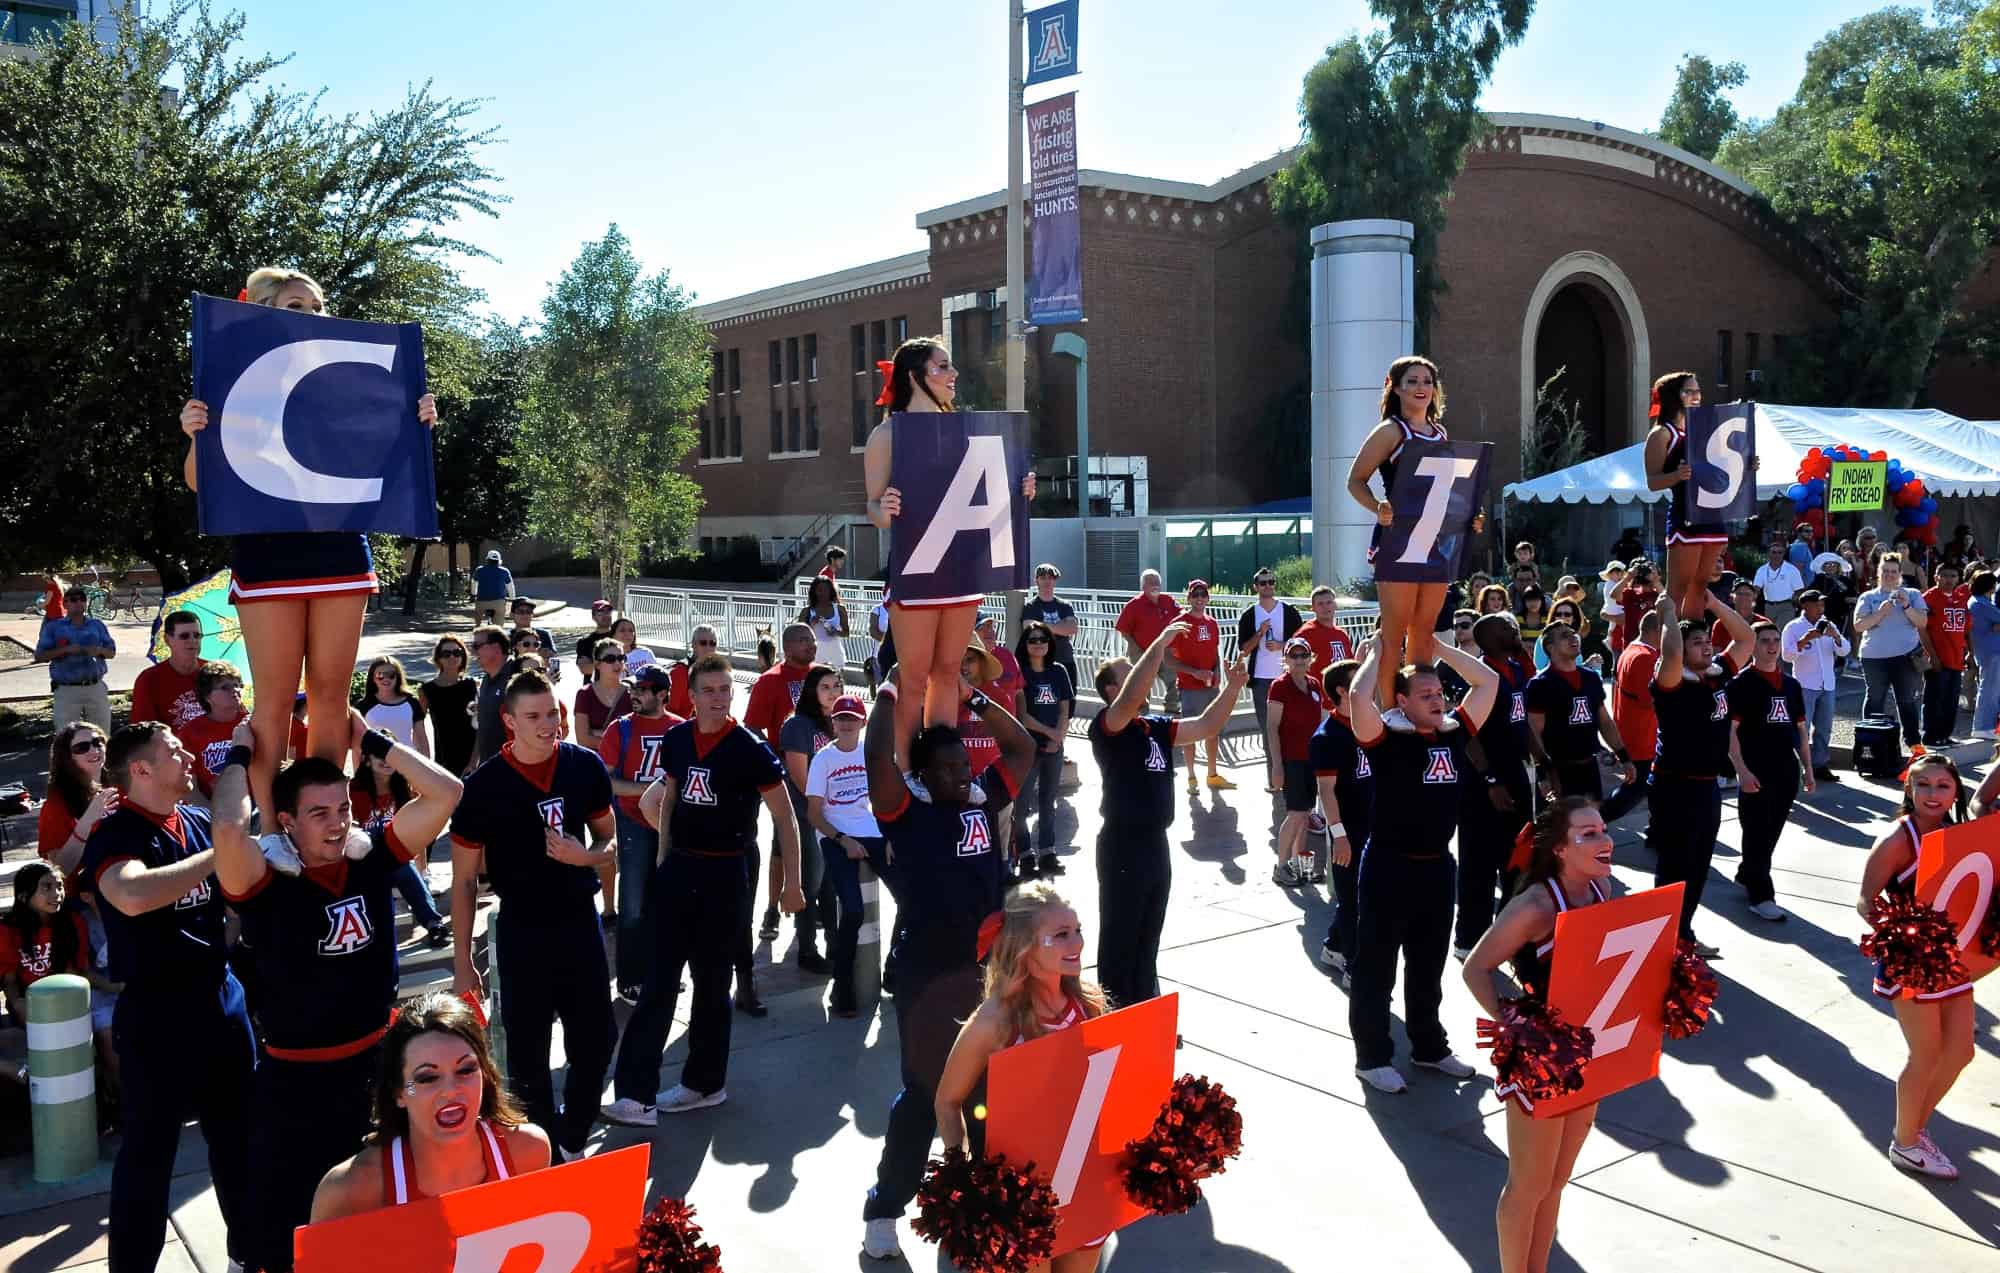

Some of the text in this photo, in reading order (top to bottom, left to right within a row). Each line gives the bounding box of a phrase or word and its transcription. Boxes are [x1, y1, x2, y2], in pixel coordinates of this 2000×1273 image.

[1033, 14, 1072, 73] A
[1030, 107, 1073, 132] WE ARE
[1031, 127, 1073, 158] fusing
[1033, 150, 1074, 170] old tires
[1034, 182, 1042, 190] to
[1034, 188, 1058, 200] ancient
[1034, 195, 1078, 218] HUNTS.
[220, 339, 397, 503] C
[1697, 417, 1747, 509] S
[1842, 467, 1874, 486] INDIAN
[901, 436, 1015, 575] A
[1395, 456, 1478, 563] T
[1831, 486, 1881, 504] FRY BREAD
[1034, 683, 1057, 704] A
[1510, 691, 1527, 723] A
[1569, 696, 1593, 725] A
[1767, 696, 1792, 724] A
[1145, 736, 1168, 772] A
[1423, 747, 1458, 784] A
[682, 766, 717, 806] A
[957, 809, 992, 857] A
[318, 895, 374, 956] A
[1583, 914, 1674, 1060] Z
